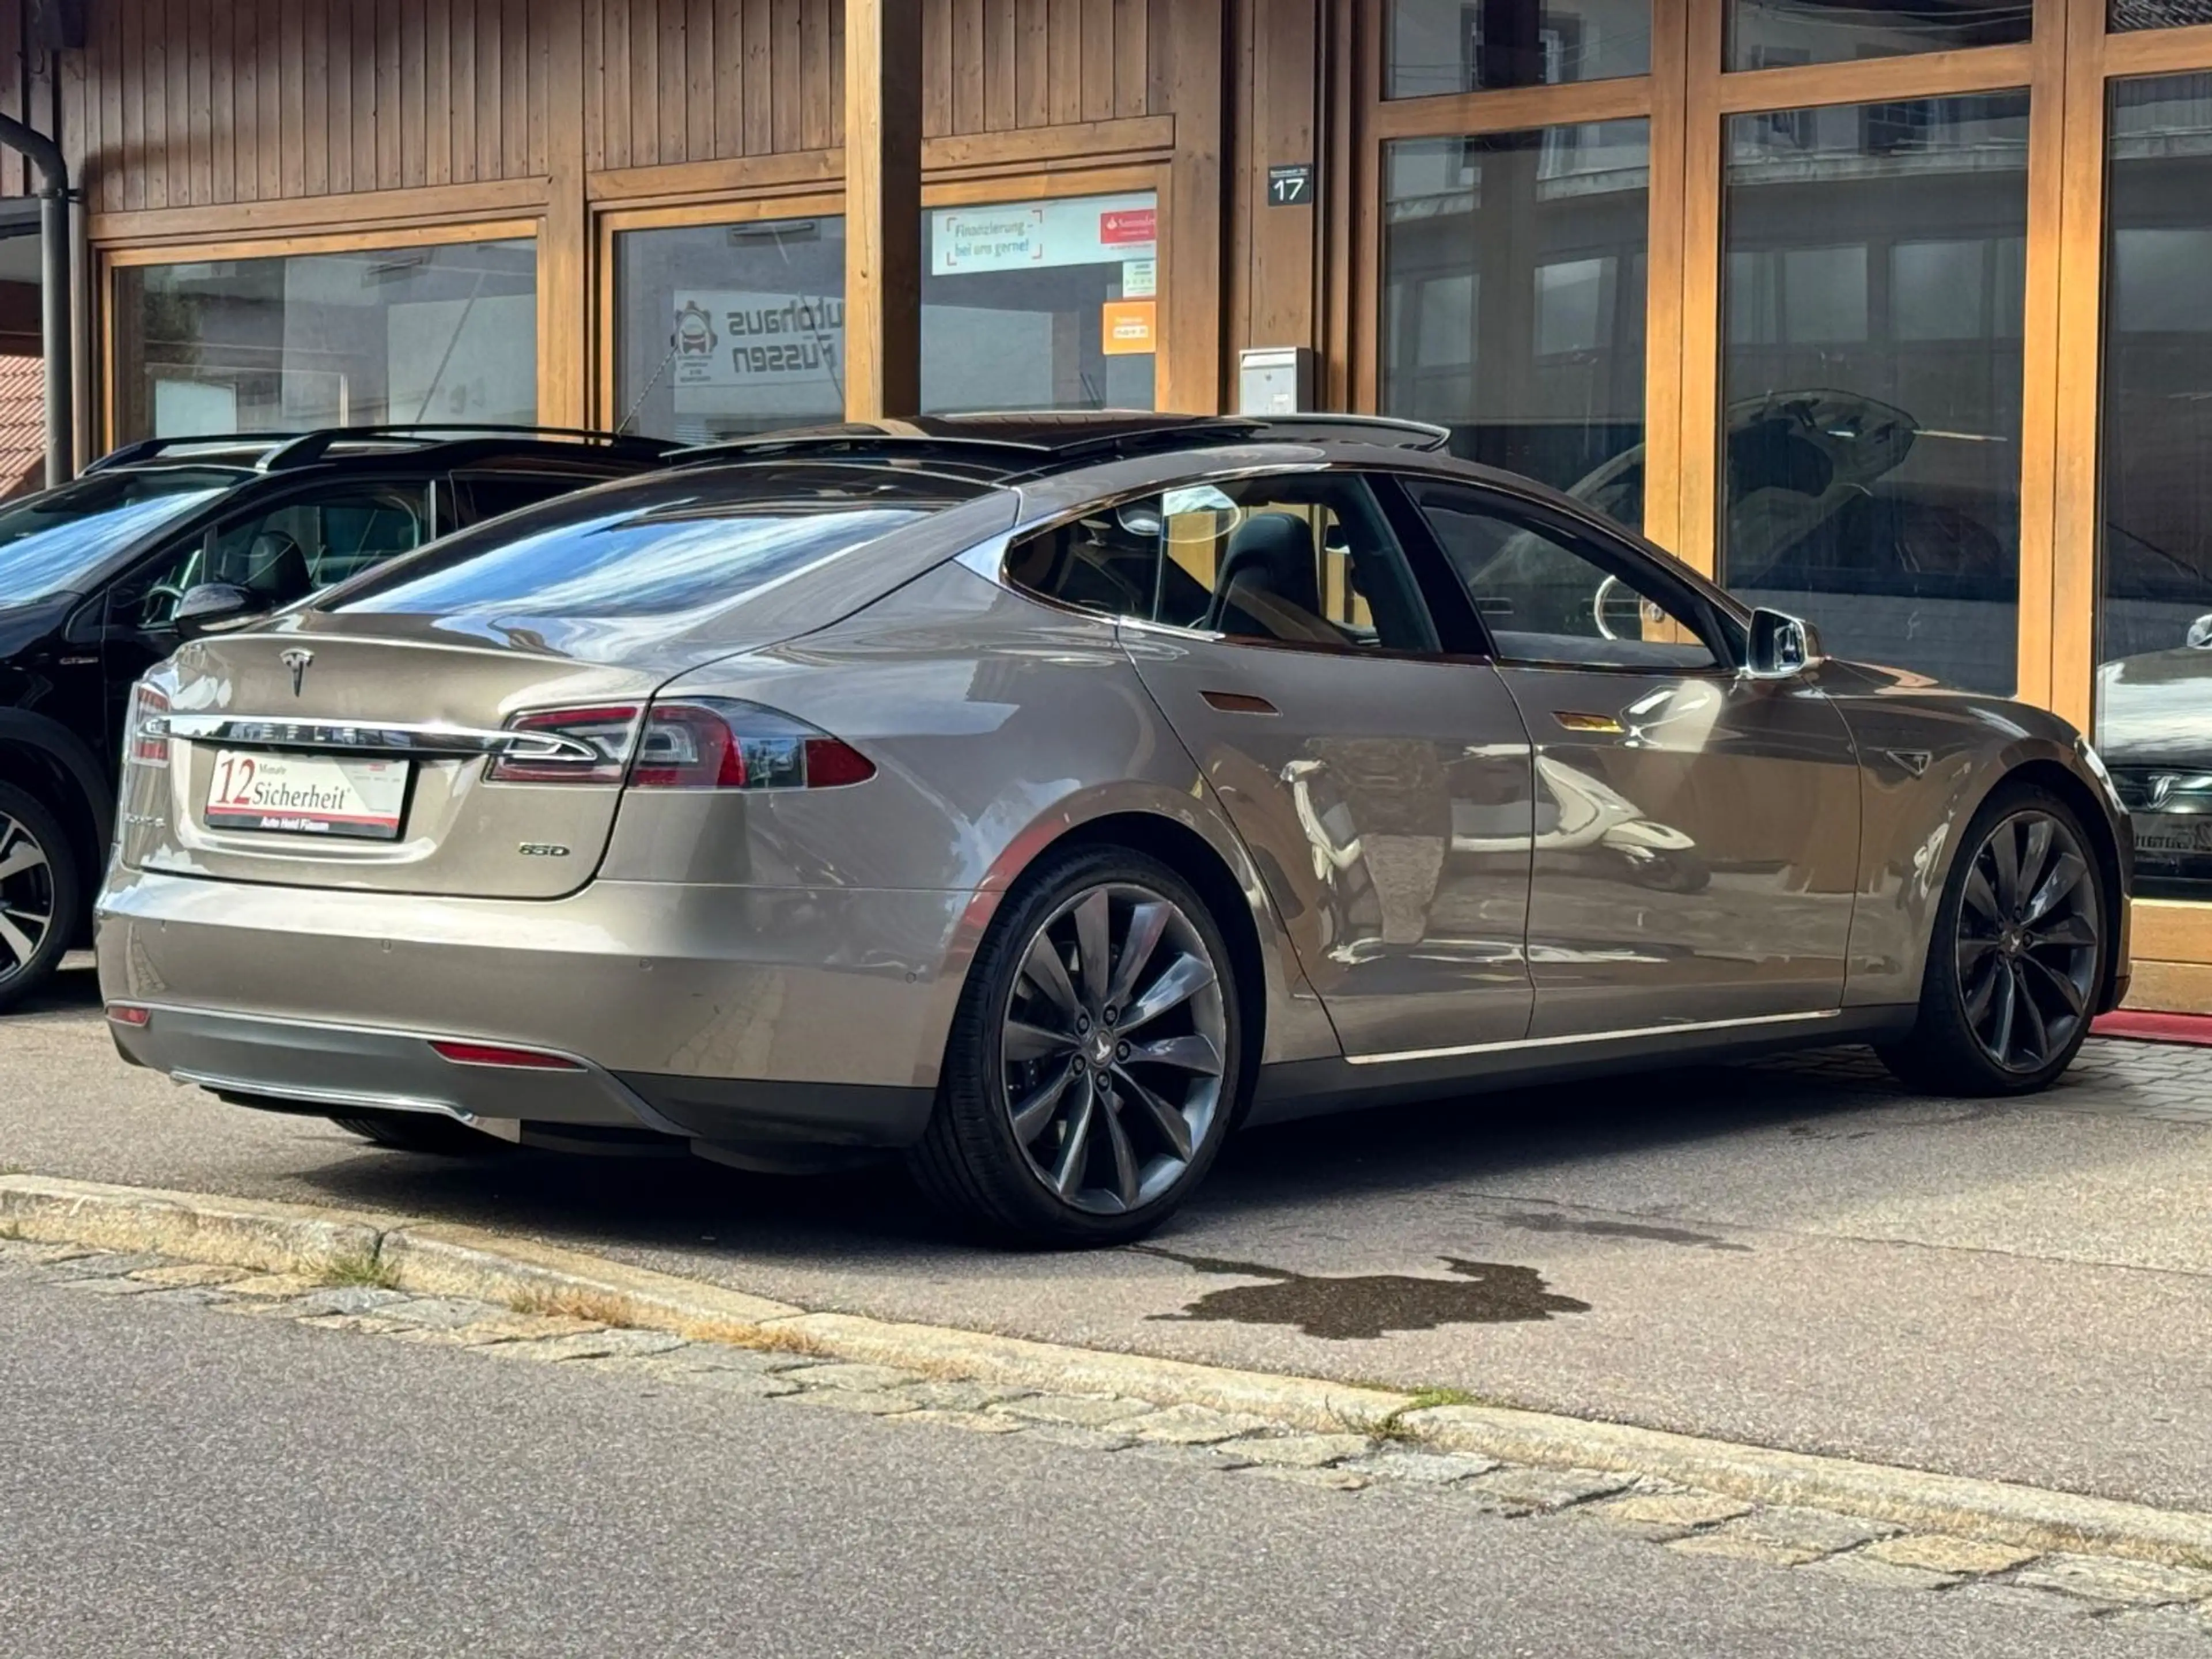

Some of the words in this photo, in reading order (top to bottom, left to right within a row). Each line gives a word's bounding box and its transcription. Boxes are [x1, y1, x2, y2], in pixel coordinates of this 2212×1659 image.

[1274, 178, 1305, 201] 17
[215, 757, 256, 805] 12
[252, 775, 346, 810] Sicherheit
